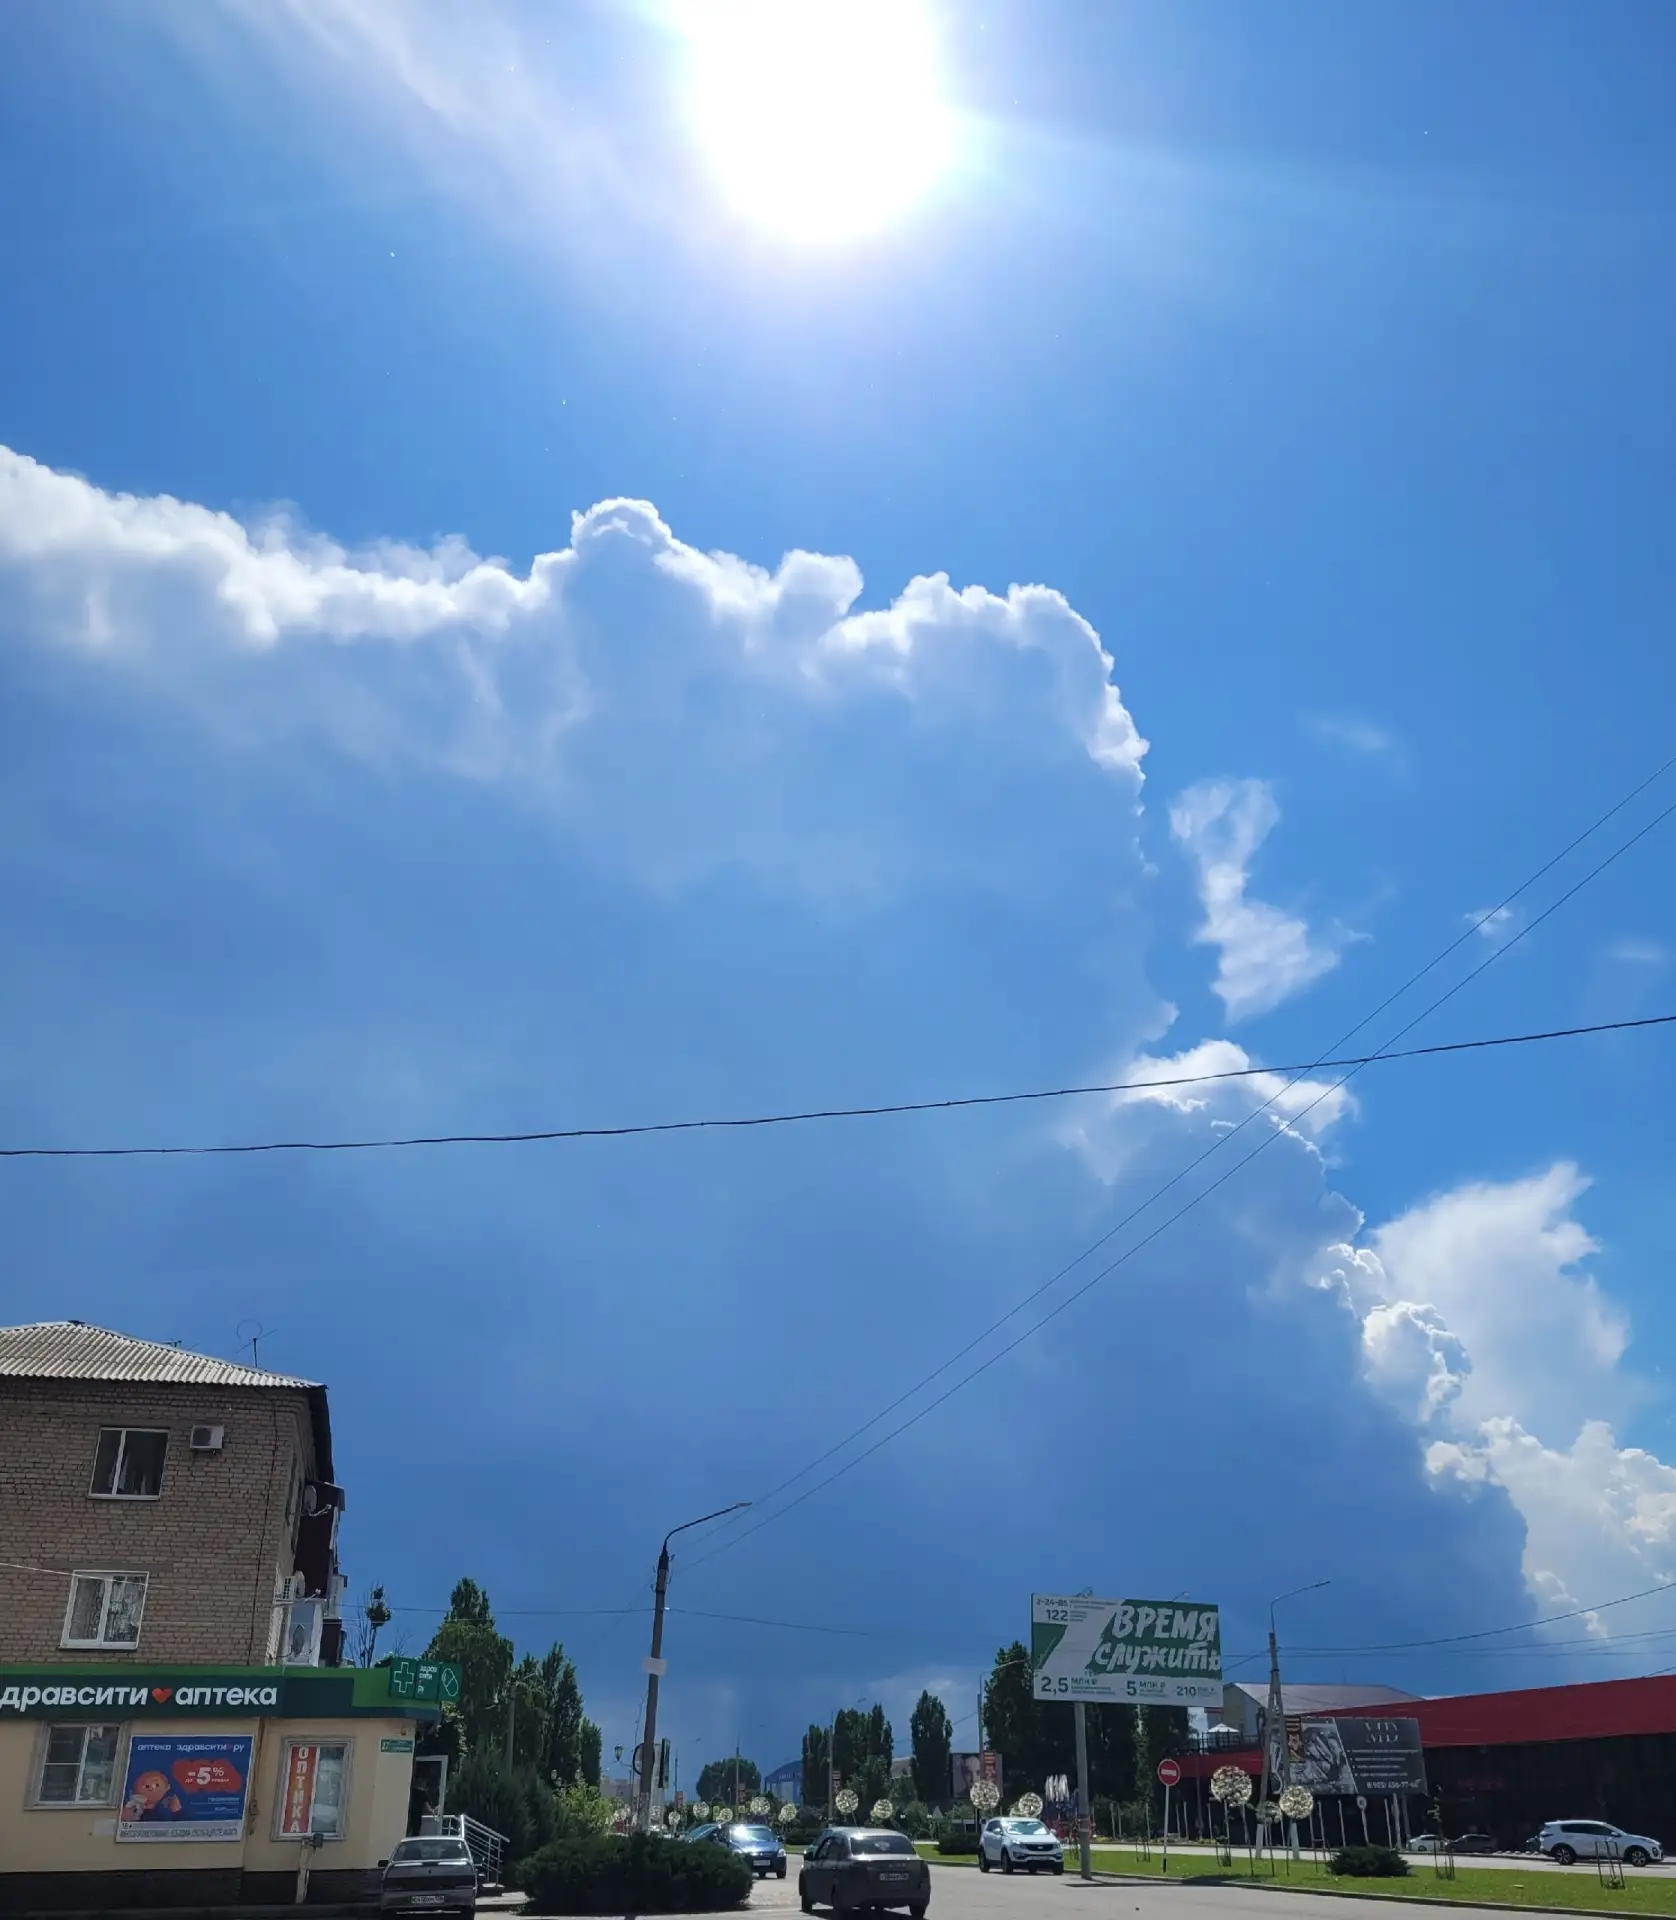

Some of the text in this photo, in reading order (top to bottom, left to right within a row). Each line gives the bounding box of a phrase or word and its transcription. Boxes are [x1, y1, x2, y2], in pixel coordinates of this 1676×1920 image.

[1046, 1609, 1068, 1621] 122
[1112, 1605, 1217, 1642] ВРЕМЯ
[1041, 1676, 1068, 1696] 2,5
[1126, 1680, 1137, 1696] 5
[1176, 1686, 1196, 1697] 210
[0, 1687, 278, 1712] дравсити аптека
[176, 1744, 227, 1753] здравсити
[233, 1744, 244, 1752] ру
[290, 1747, 309, 1833] ОПТИКА
